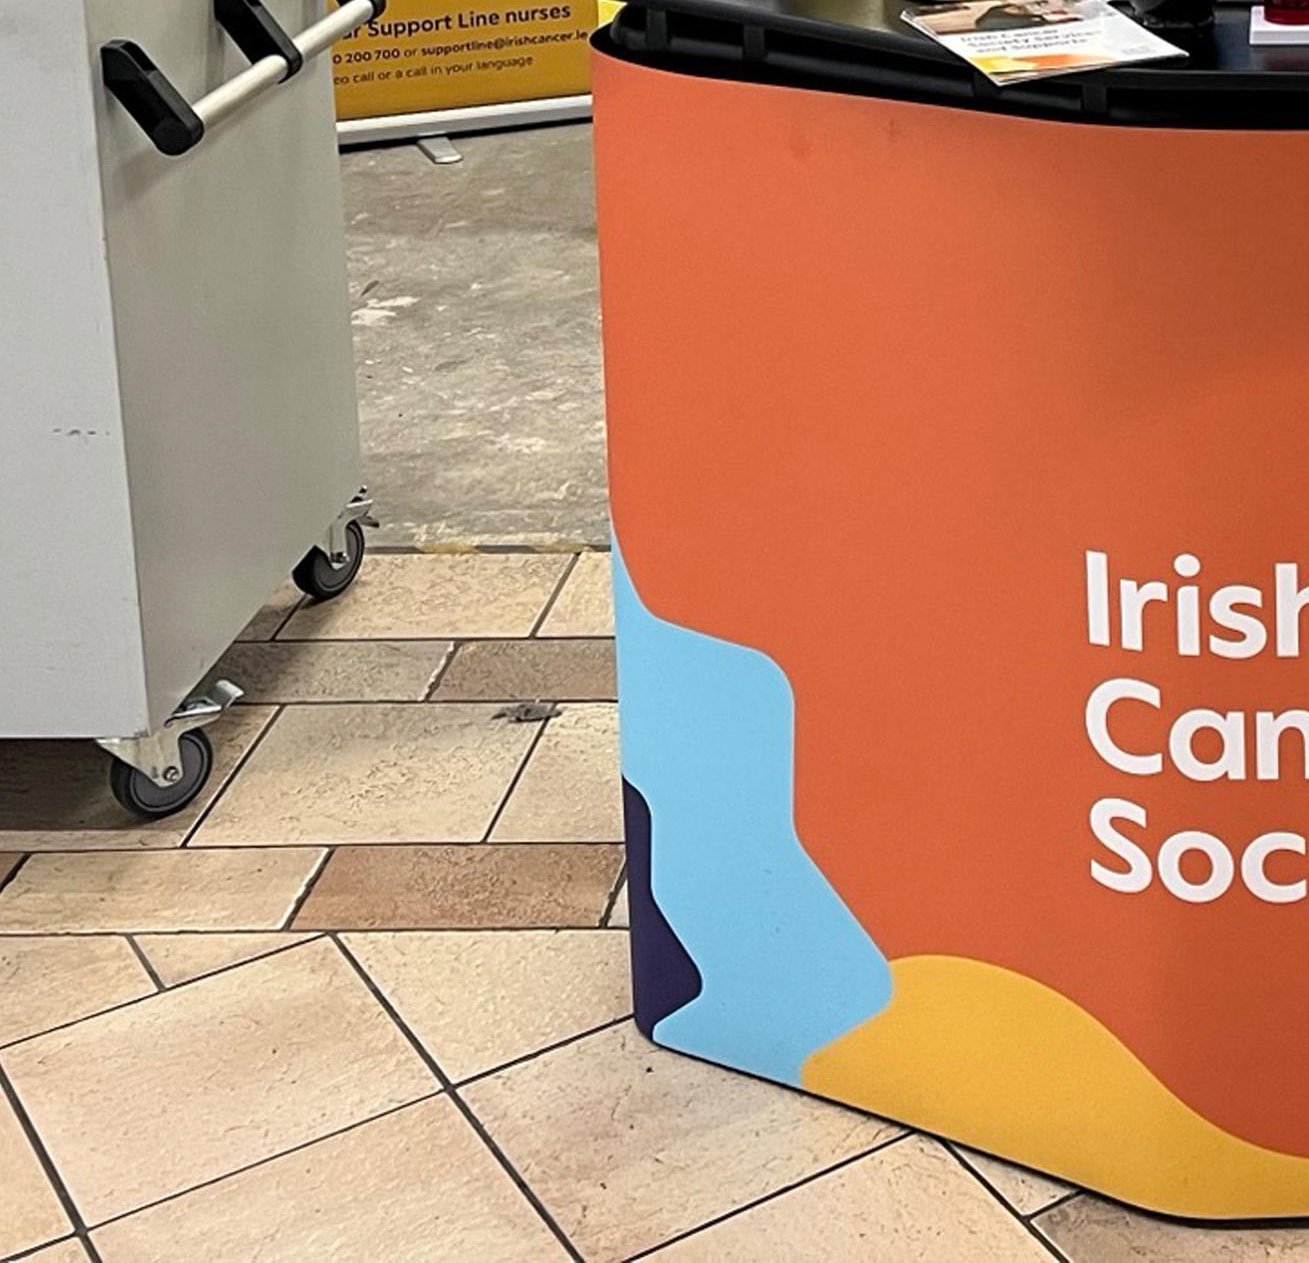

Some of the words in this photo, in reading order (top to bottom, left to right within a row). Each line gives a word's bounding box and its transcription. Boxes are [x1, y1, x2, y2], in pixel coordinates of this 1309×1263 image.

[367, 16, 452, 39] Support
[458, 12, 500, 29] Line
[505, 5, 571, 23] nurses
[347, 52, 372, 63] 200
[375, 49, 400, 60] 700
[404, 49, 417, 58] or
[353, 71, 374, 83] call
[378, 70, 392, 80] or
[395, 69, 403, 78] a
[406, 66, 427, 78] call
[430, 65, 442, 75] in
[444, 61, 473, 75] your
[477, 55, 534, 71] language
